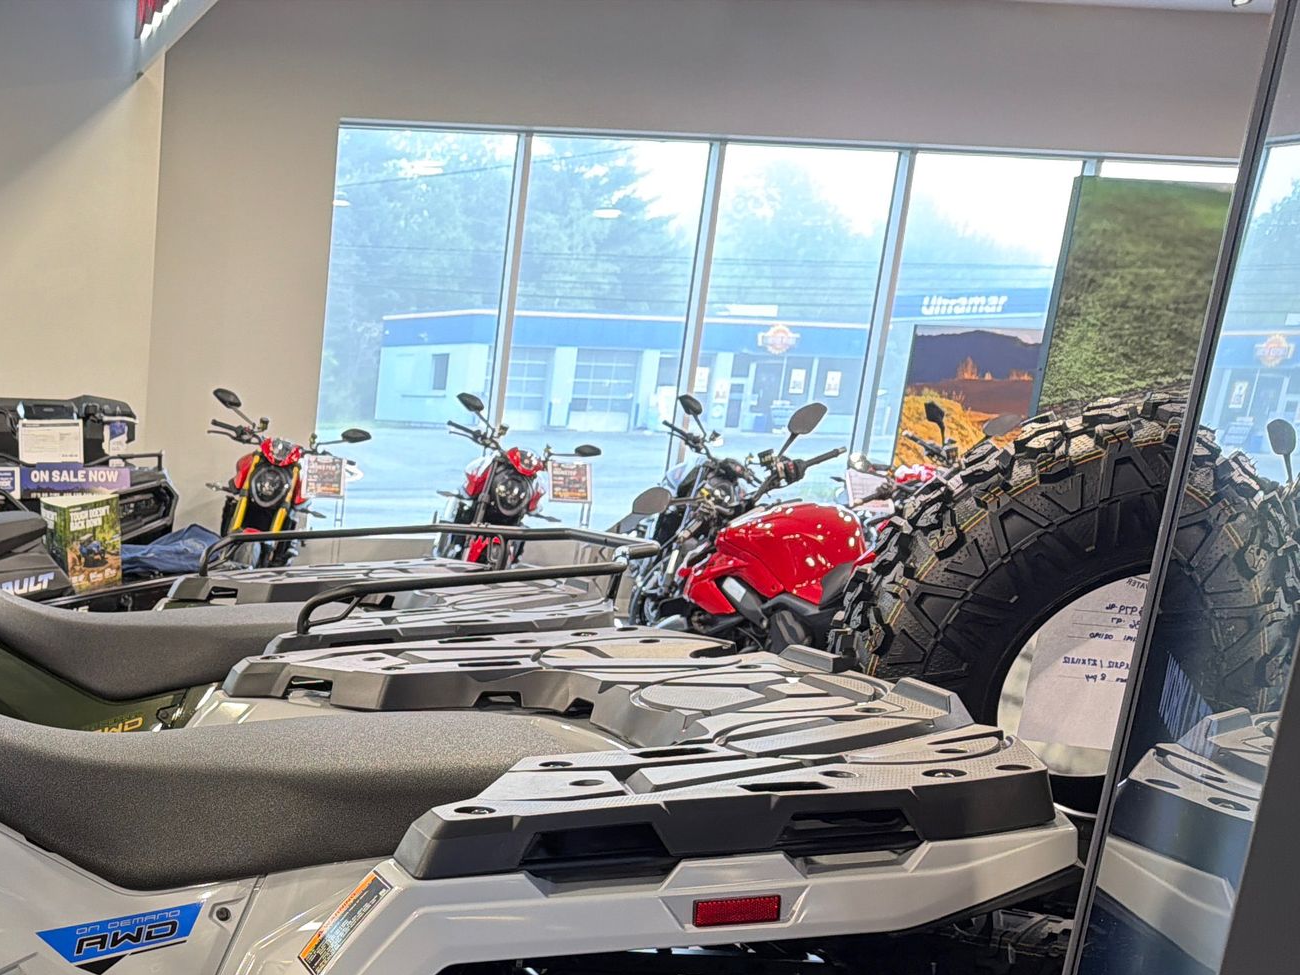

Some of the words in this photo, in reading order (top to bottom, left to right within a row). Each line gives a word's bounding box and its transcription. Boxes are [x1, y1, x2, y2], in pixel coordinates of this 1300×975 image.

[30, 470, 50, 483] ON
[51, 470, 86, 482] SALE
[88, 470, 119, 482] NOW
[76, 925, 100, 935] ON
[107, 909, 181, 930] DEMAND
[74, 919, 180, 957] AWD
